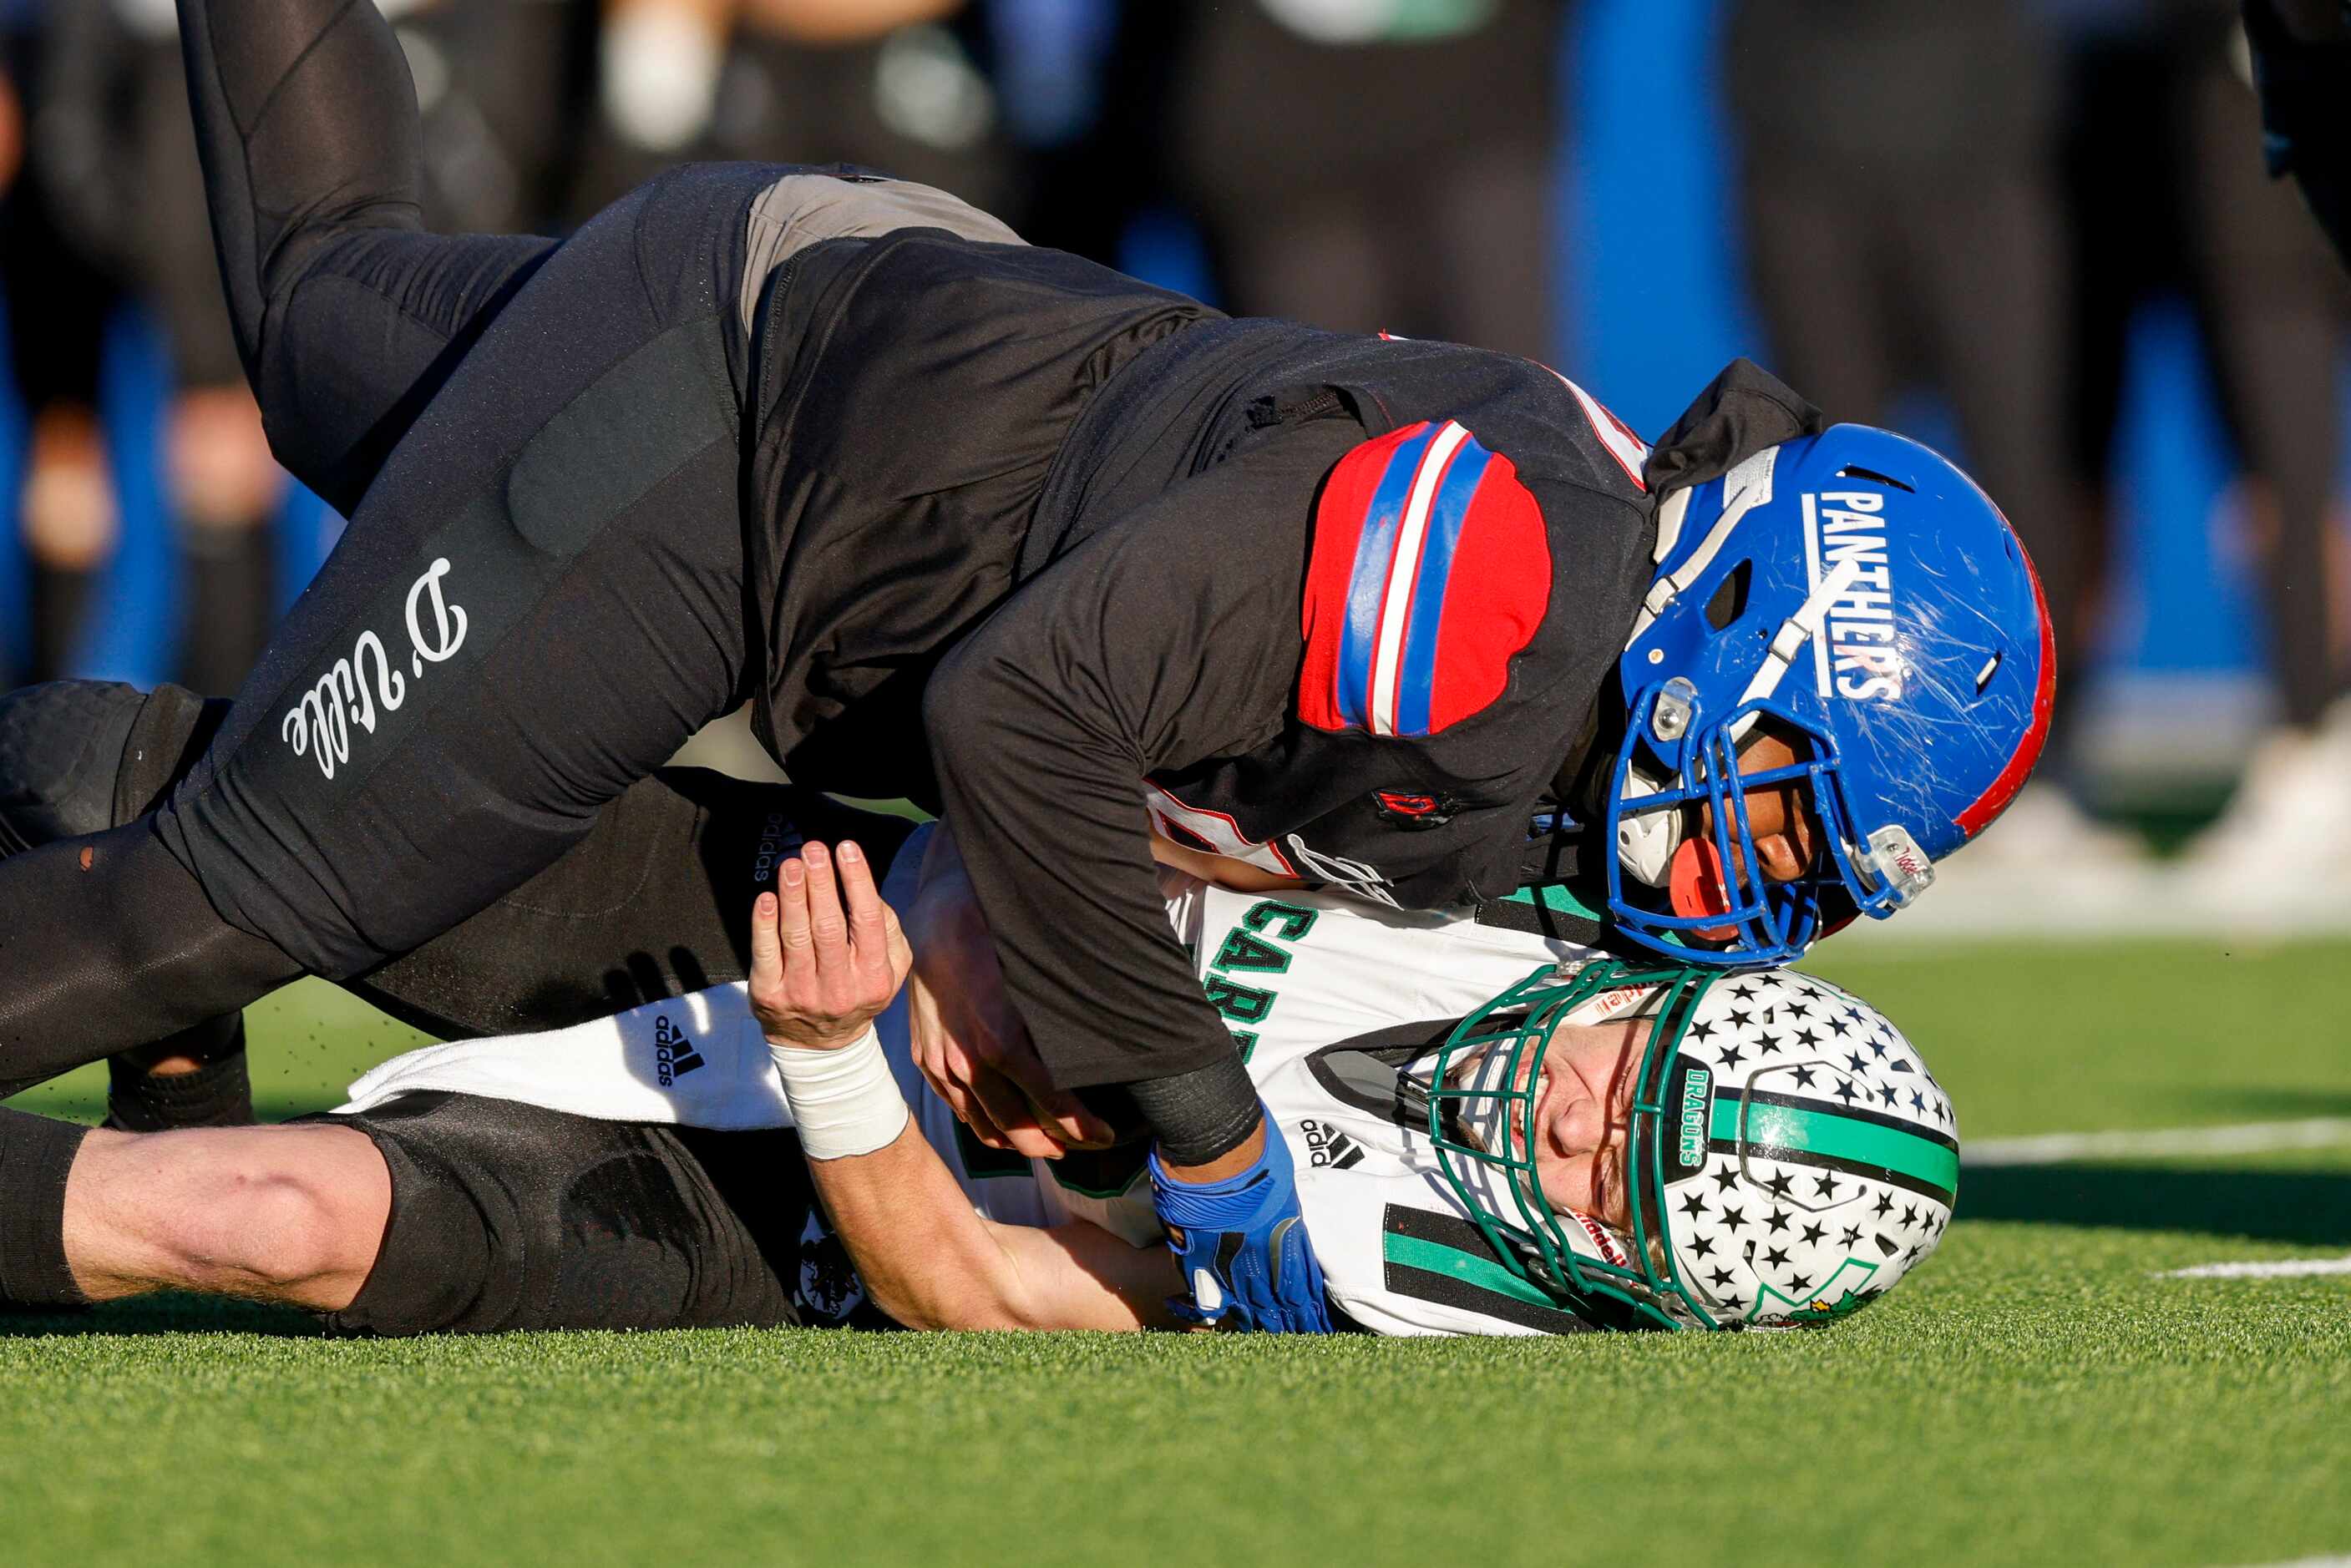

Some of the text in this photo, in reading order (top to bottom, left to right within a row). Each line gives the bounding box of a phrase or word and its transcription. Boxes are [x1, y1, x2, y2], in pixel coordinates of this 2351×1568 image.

[1820, 491, 1902, 701] PANTHERS
[755, 812, 784, 883] adidas
[655, 1014, 674, 1088] adidas
[1680, 1068, 1709, 1166] DRAGONS
